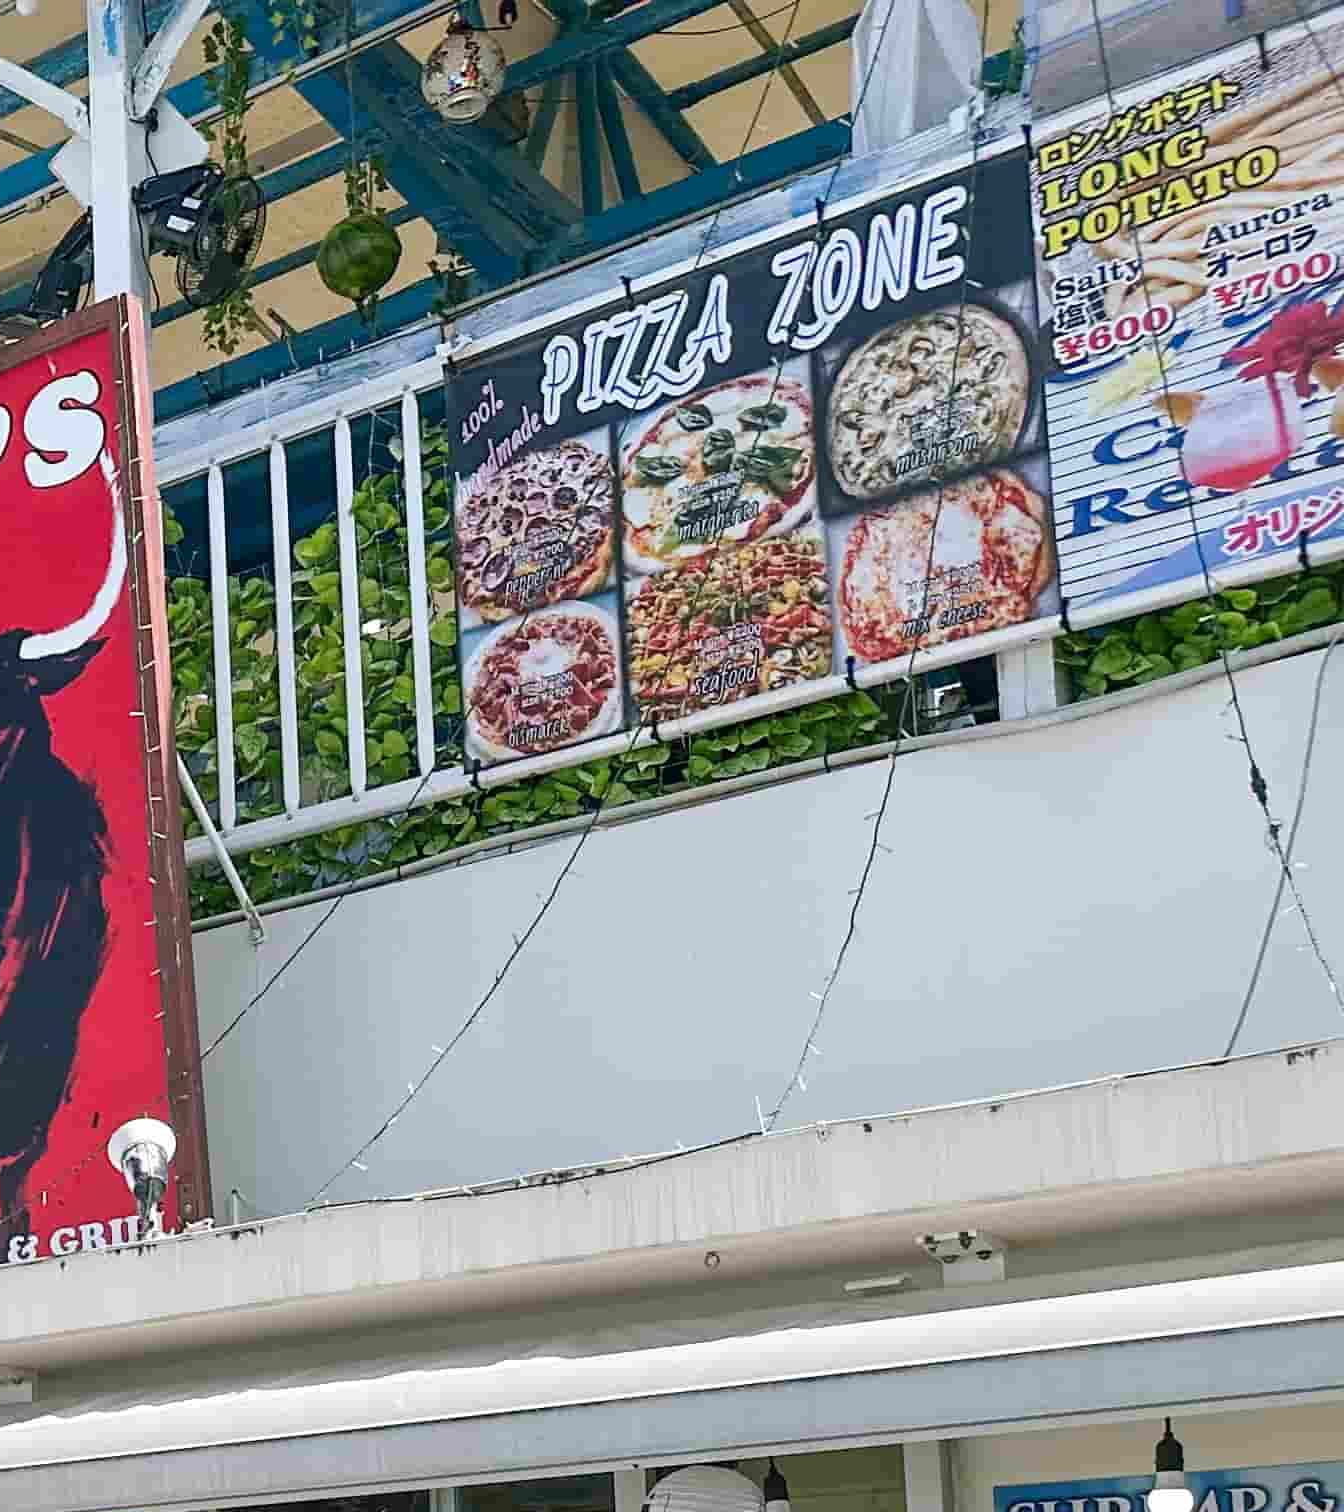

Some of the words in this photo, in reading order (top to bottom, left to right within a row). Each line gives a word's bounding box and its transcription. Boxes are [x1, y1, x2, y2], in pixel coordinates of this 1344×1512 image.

[1039, 76, 1242, 175] ロングポテト
[1040, 126, 1209, 216] LONG
[1042, 145, 1280, 260] POTATO
[1202, 192, 1333, 249] Aurora
[1056, 258, 1143, 300] Salty
[1206, 224, 1318, 279] オーロラ
[541, 274, 733, 425] PIZZA
[769, 185, 967, 350] ZONE
[1214, 254, 1337, 309] ¥700
[1057, 308, 1175, 364] ¥600
[896, 431, 979, 475] mushroom
[694, 651, 760, 705] seafood
[9, 1234, 41, 1264] &
